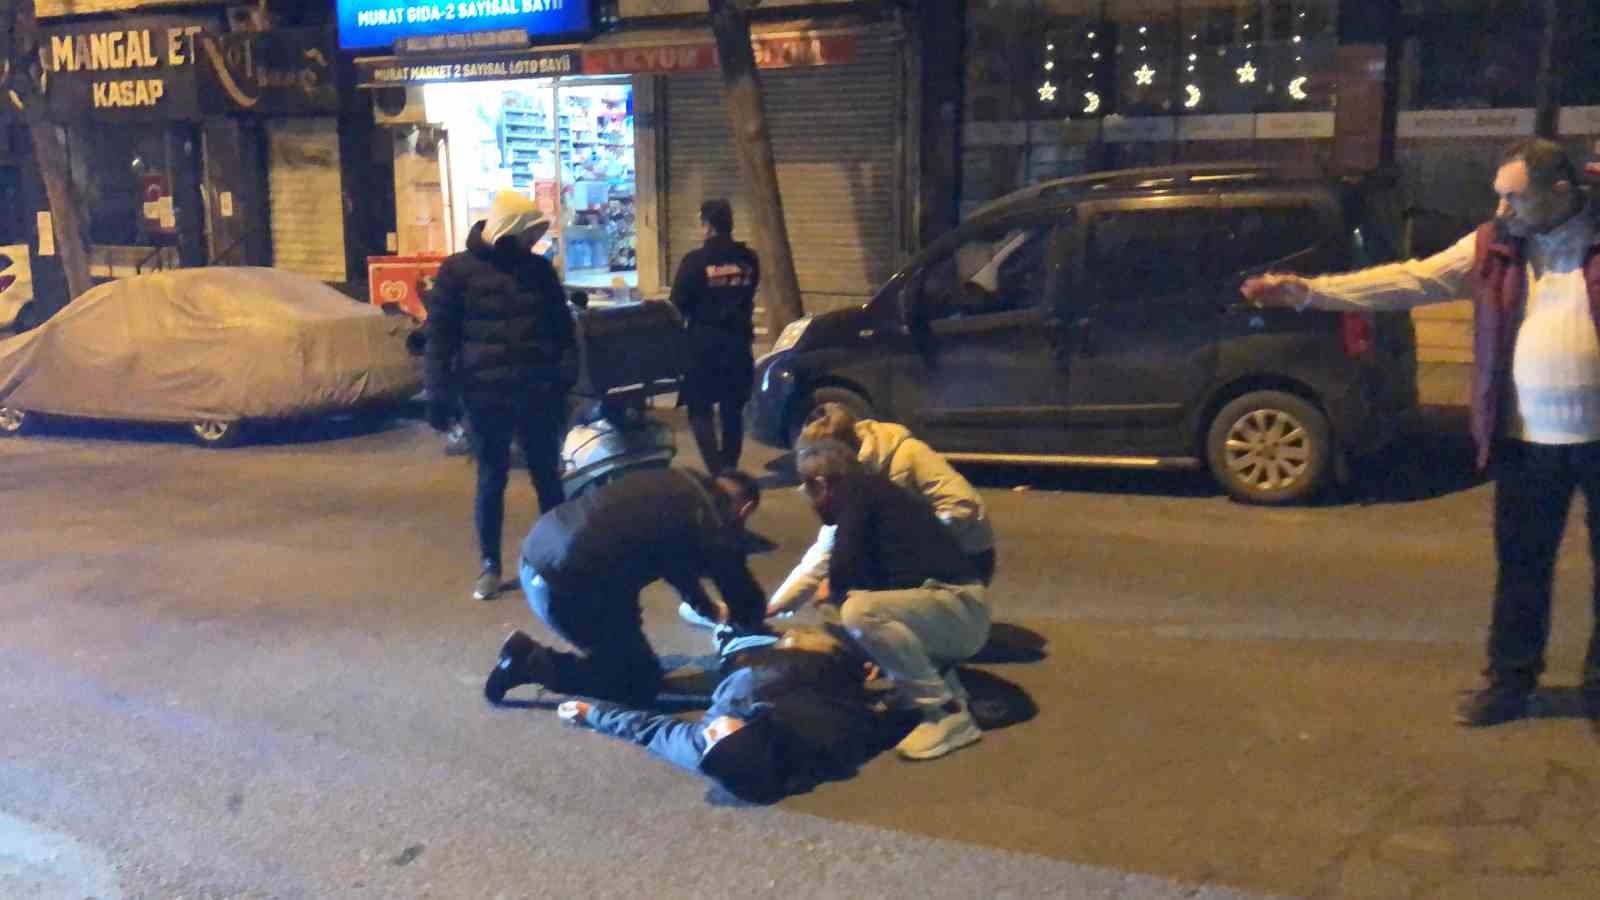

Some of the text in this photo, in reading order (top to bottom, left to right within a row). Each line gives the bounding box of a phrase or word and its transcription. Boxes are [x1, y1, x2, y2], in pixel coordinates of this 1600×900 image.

[358, 8, 404, 27] MURAT
[51, 29, 158, 72] MANGAL
[167, 26, 202, 65] ET
[374, 66, 409, 81] MURAT
[410, 64, 452, 81] MARKET
[454, 63, 462, 77] 2
[463, 62, 508, 77] SAYISAL
[93, 79, 163, 108] KASAP
